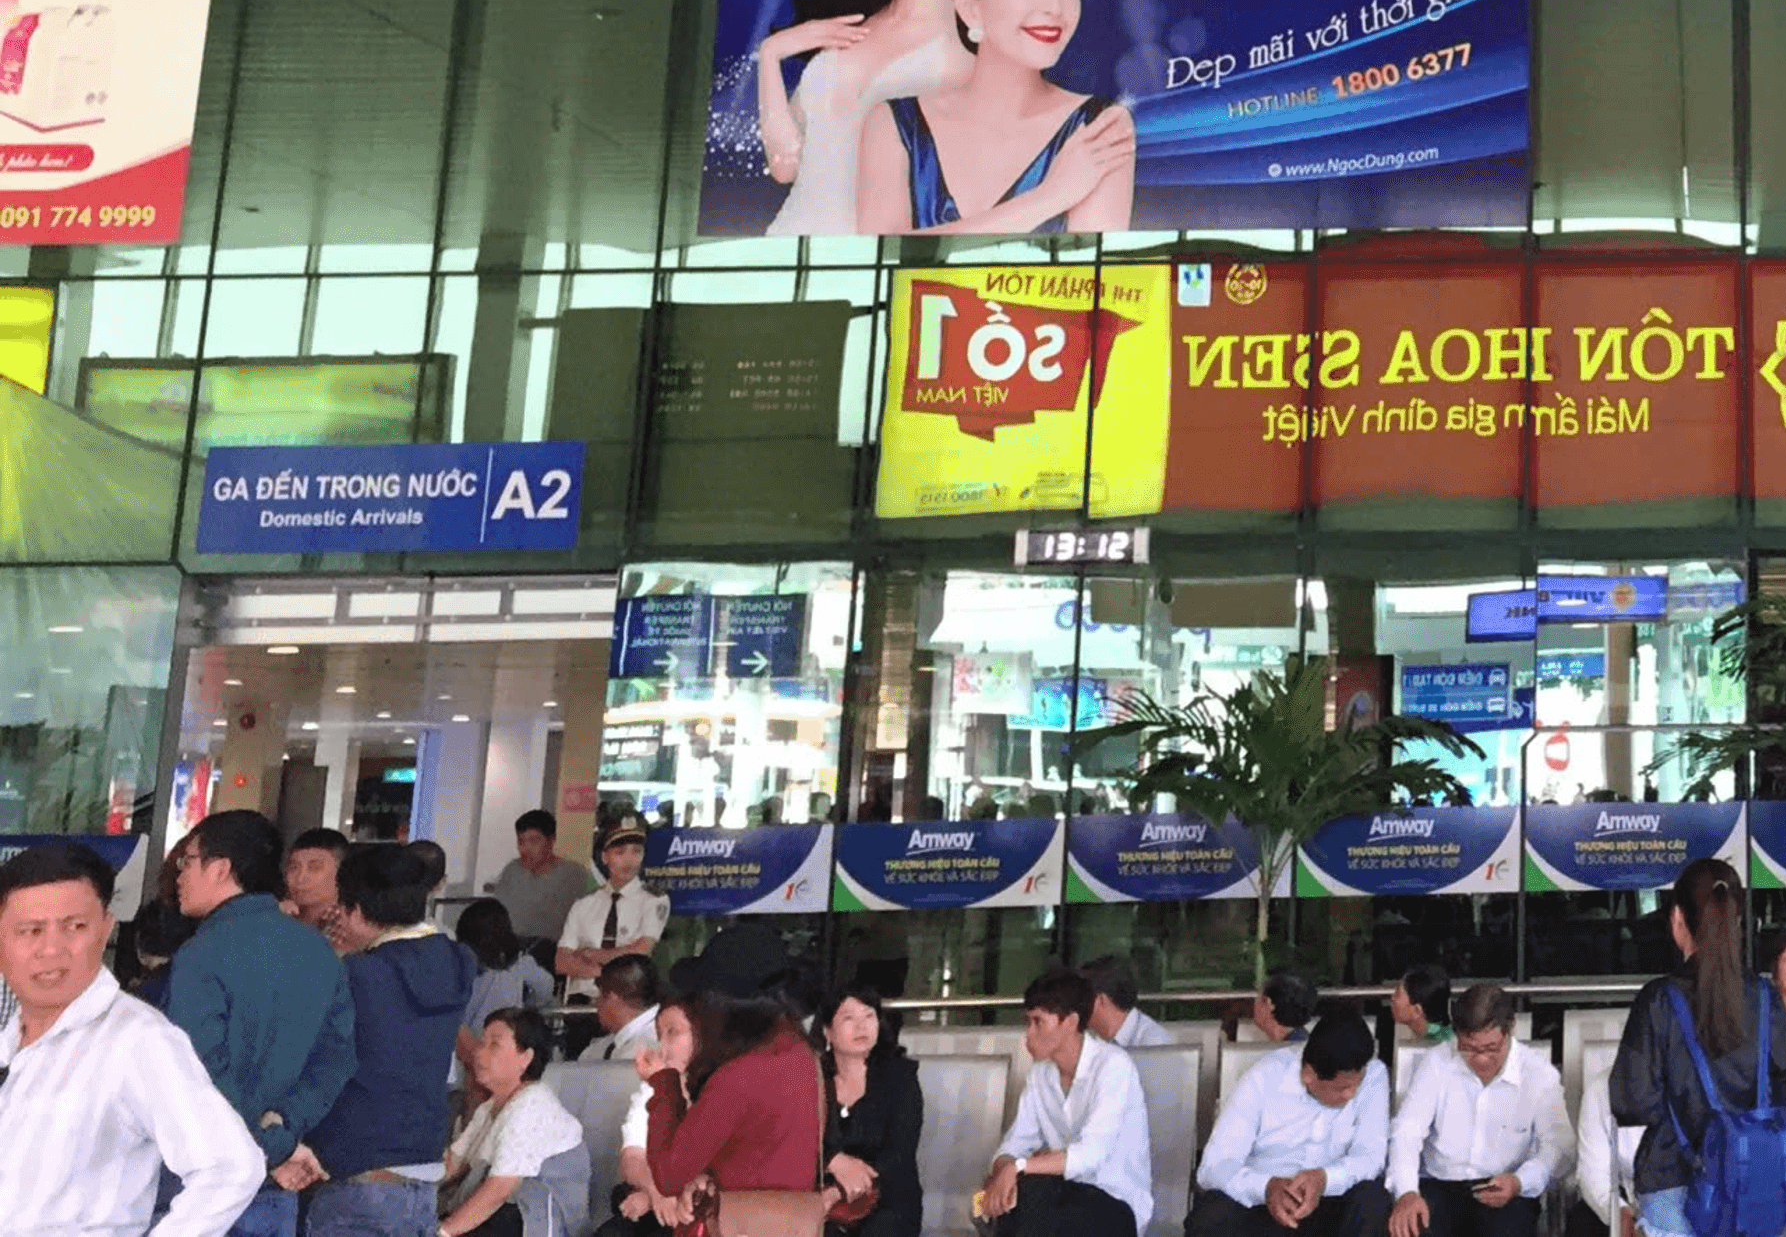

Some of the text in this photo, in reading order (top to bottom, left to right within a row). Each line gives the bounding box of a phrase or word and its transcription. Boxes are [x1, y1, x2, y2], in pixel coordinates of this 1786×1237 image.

[1166, 54, 1236, 89] Đẹp
[1249, 29, 1294, 68] mãi
[1306, 13, 1349, 50] với
[1227, 42, 1472, 119] HOTLINE 1800 6377
[1285, 147, 1439, 177] www.NgocDung.com
[0, 205, 156, 229] 091 774 9999
[213, 468, 478, 501] GA ĐẾN TRONG NƯỚC
[490, 469, 572, 520] A2
[260, 508, 424, 528] Domestic Arrivals
[1141, 821, 1207, 843] Amway
[1368, 816, 1435, 838] Amway
[1596, 811, 1661, 833] Amway
[667, 836, 736, 859] Amway
[907, 829, 975, 851] Amway
